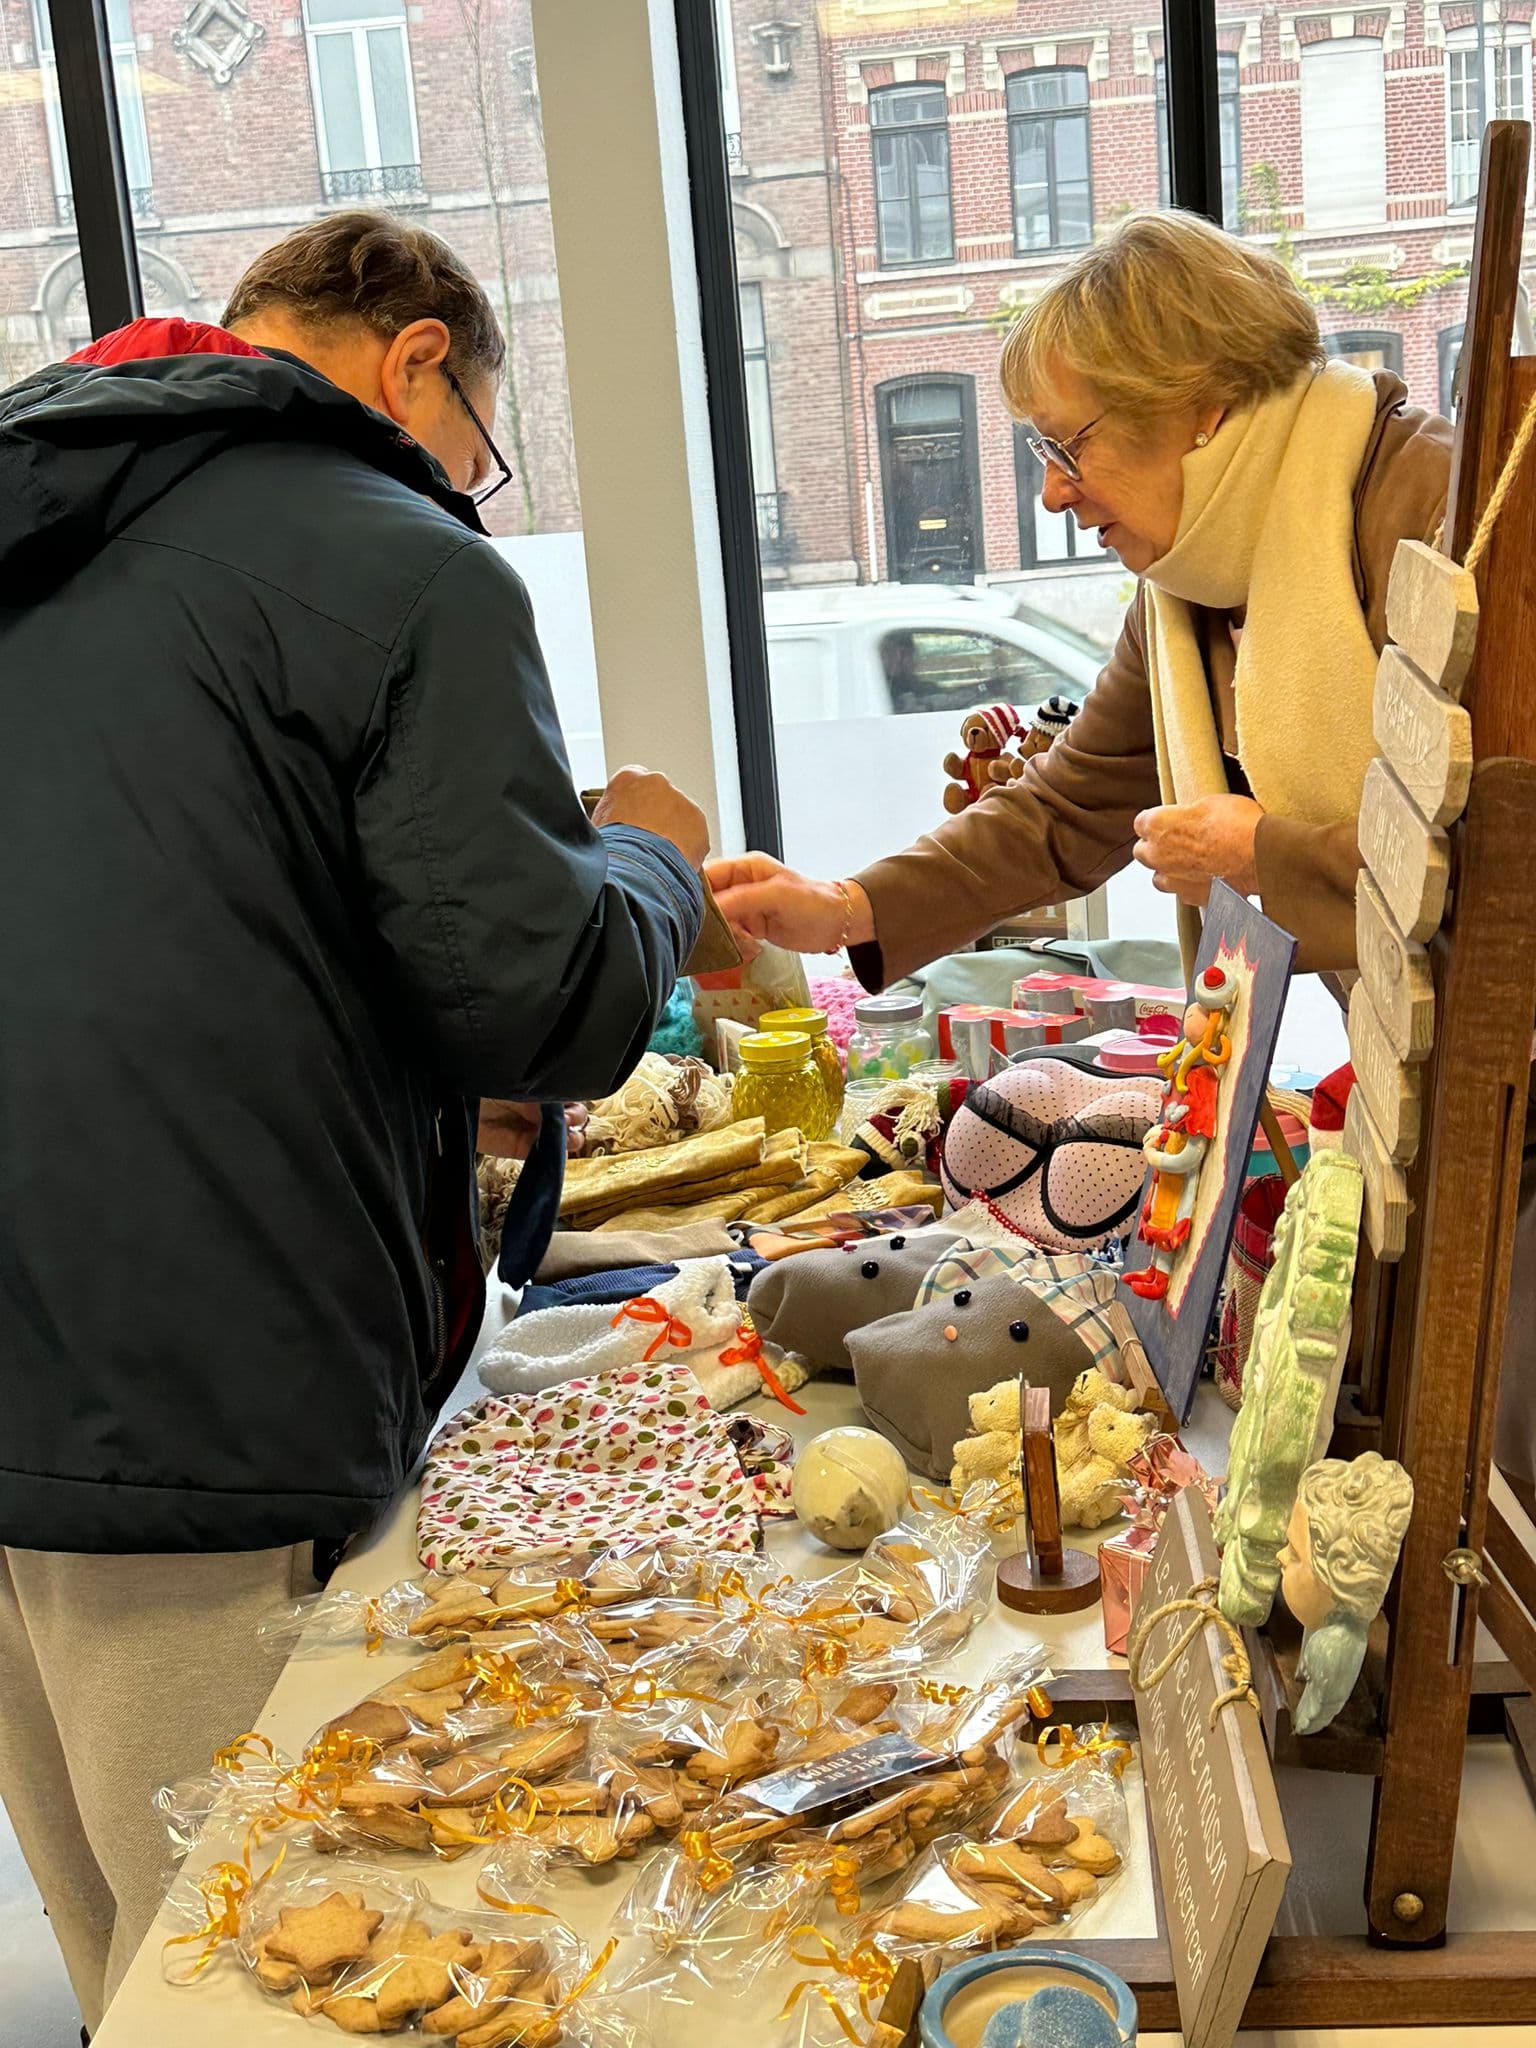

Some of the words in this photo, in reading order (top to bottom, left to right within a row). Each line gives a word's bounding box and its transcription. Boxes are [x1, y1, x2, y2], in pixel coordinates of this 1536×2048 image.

[1155, 1539, 1170, 1595] Le
[1181, 1679, 1205, 1776] d'une
[1196, 1762, 1228, 1922] maison,
[1157, 1748, 1175, 1793] qui
[1165, 1775, 1177, 1826] la
[1170, 1803, 1208, 1991] fréquentent
